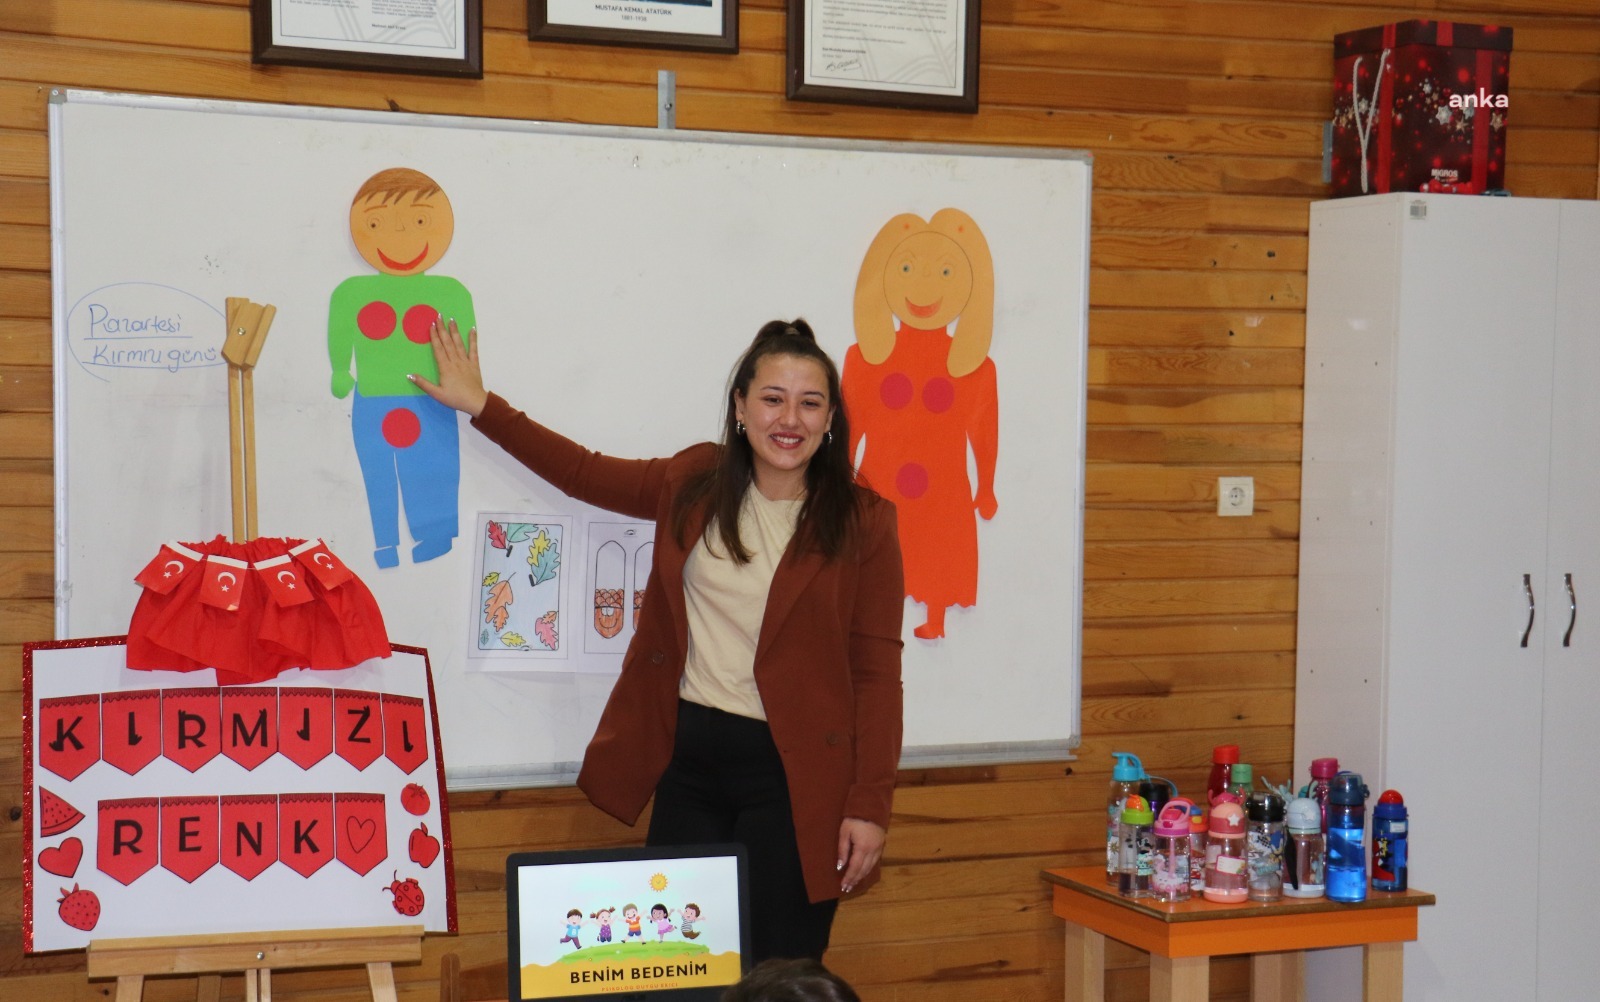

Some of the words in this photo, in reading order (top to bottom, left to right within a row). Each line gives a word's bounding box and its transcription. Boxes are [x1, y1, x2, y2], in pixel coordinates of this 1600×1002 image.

[595, 4, 623, 12] MUSTAFA
[88, 303, 181, 338] Pazartesi
[168, 347, 216, 373] günü
[112, 816, 319, 857] RENK
[570, 966, 624, 984] BENİM
[631, 961, 707, 980] BEDENİM
